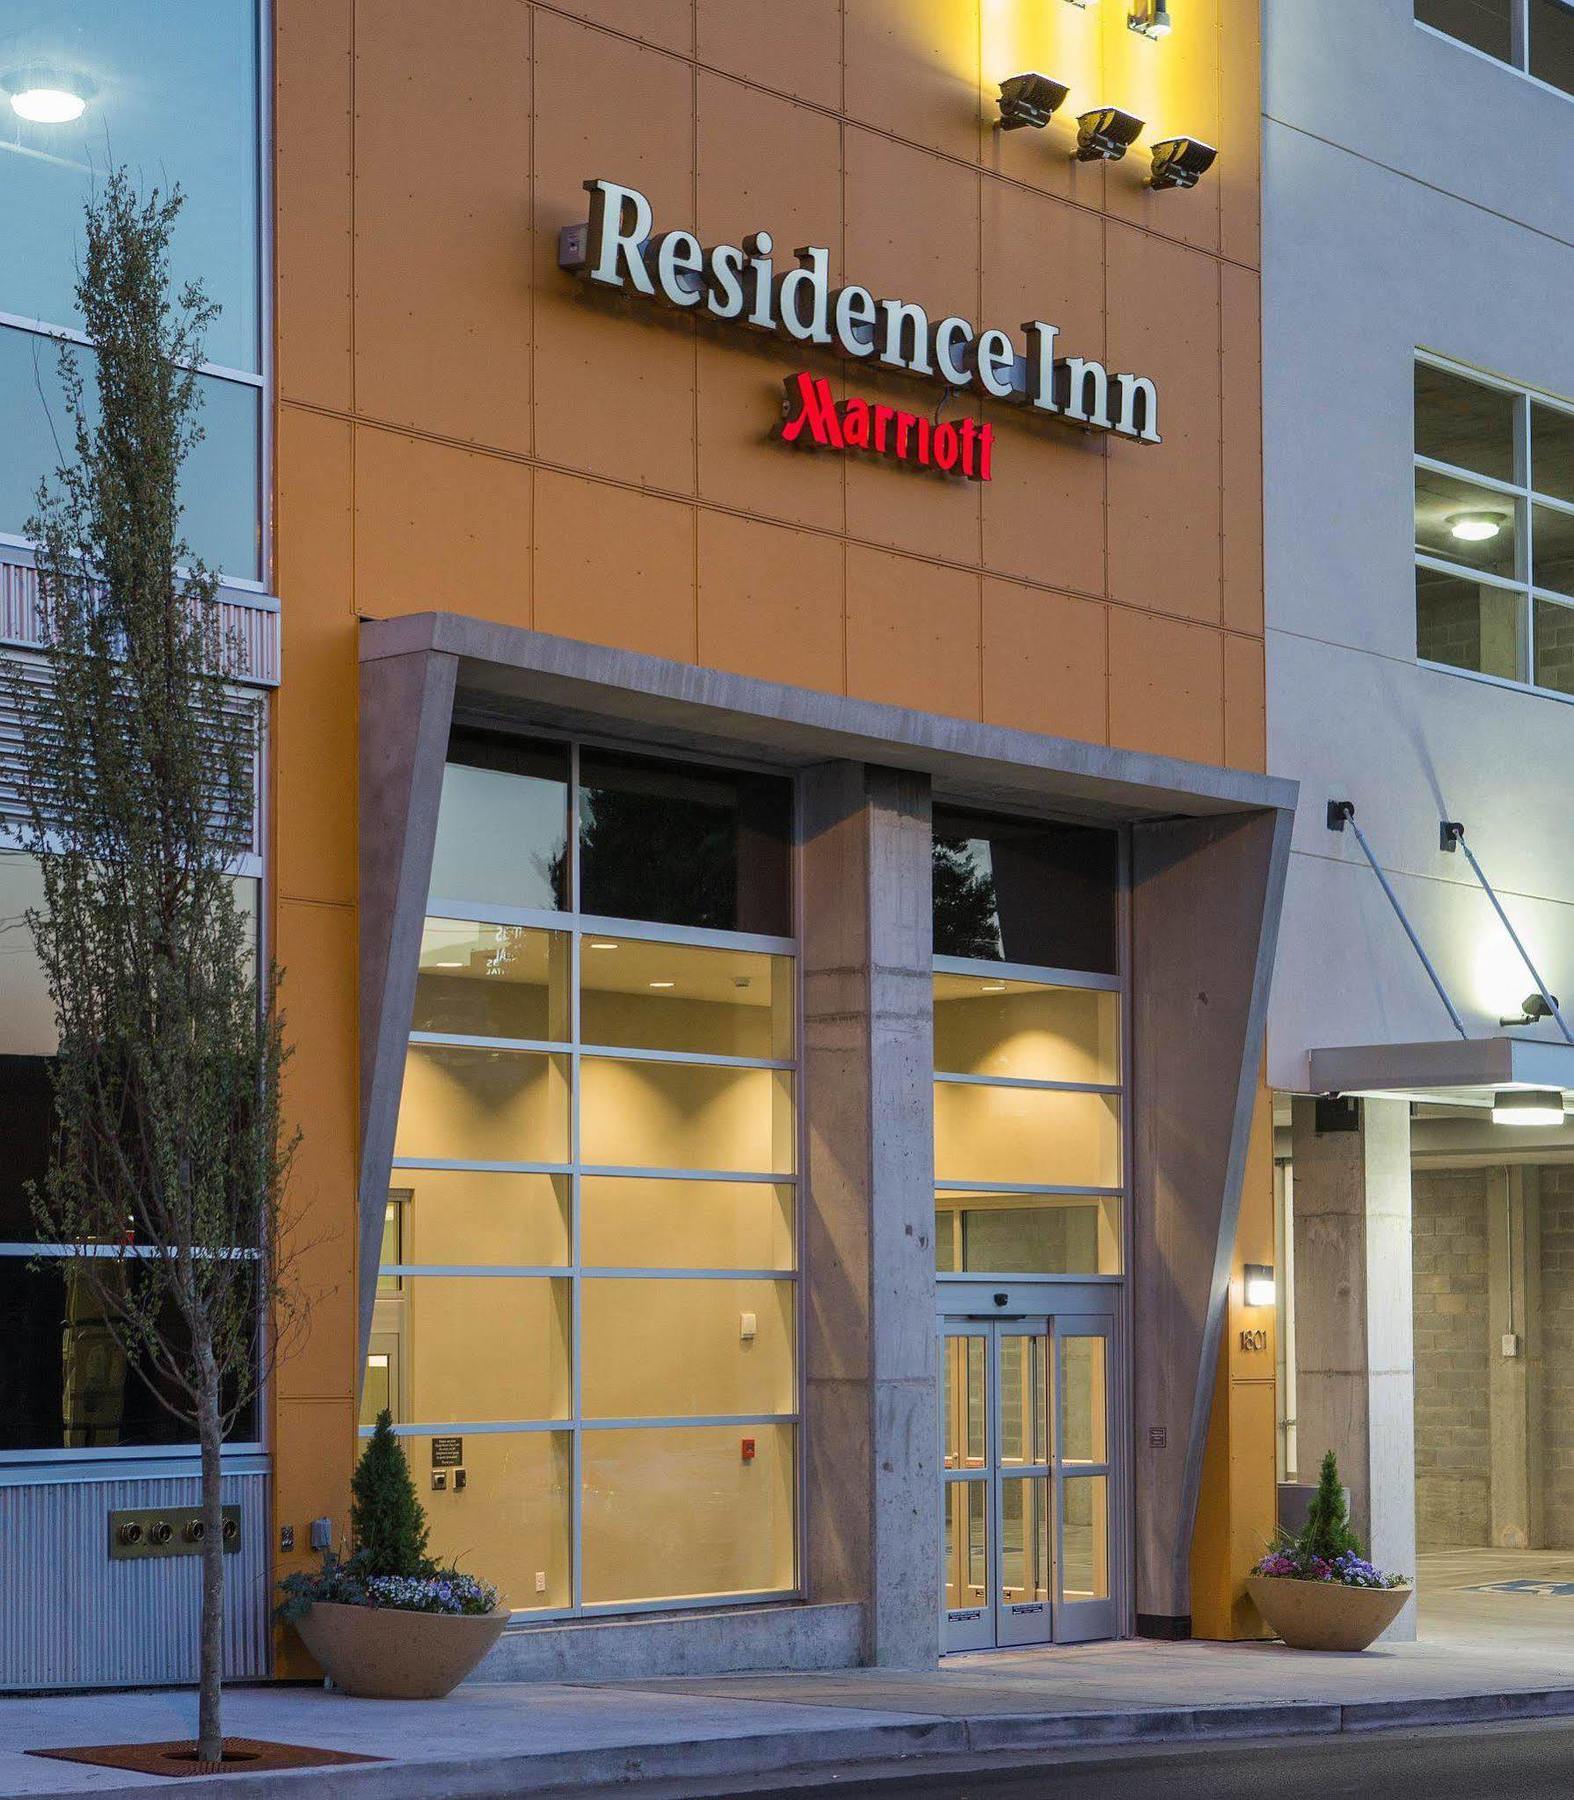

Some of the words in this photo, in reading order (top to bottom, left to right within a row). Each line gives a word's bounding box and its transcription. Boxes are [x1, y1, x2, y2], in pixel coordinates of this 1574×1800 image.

[589, 179, 1014, 397] Residence
[1032, 320, 1163, 444] Inn
[781, 370, 996, 482] Marriott
[1239, 1329, 1267, 1351] 1801
